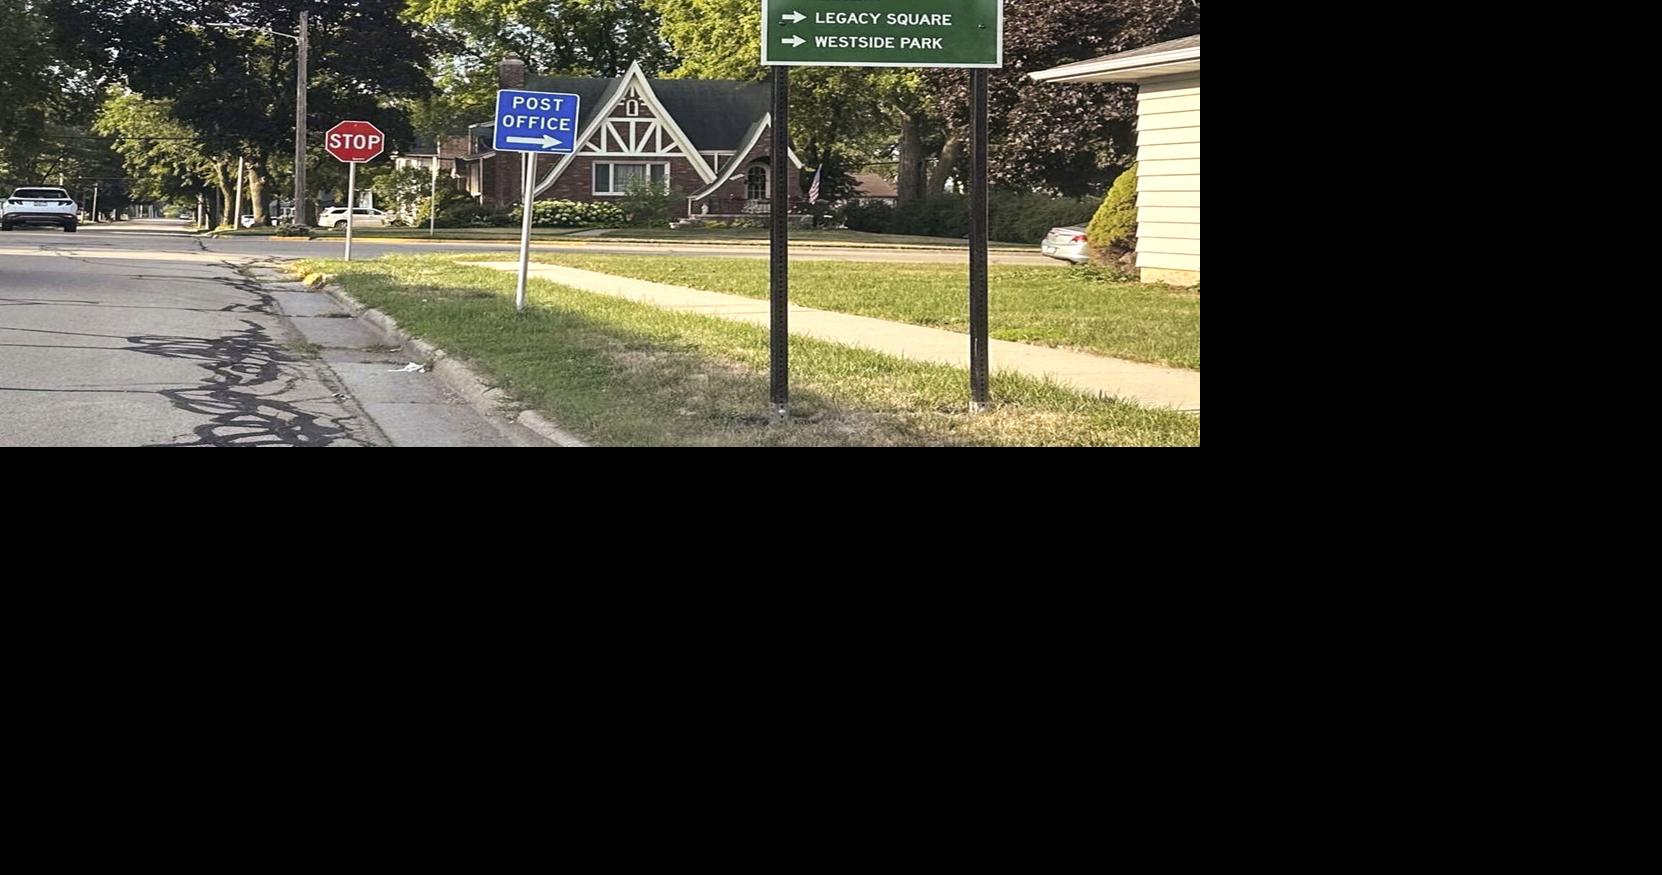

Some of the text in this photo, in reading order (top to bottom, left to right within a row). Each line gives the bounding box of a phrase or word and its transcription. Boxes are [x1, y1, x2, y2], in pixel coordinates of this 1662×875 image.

[815, 12, 952, 26] LEGACY SQUARE
[815, 36, 943, 49] WESTSIDE PARK
[512, 96, 564, 111] POST
[502, 115, 571, 131] OFFICE
[329, 133, 381, 150] STOP
